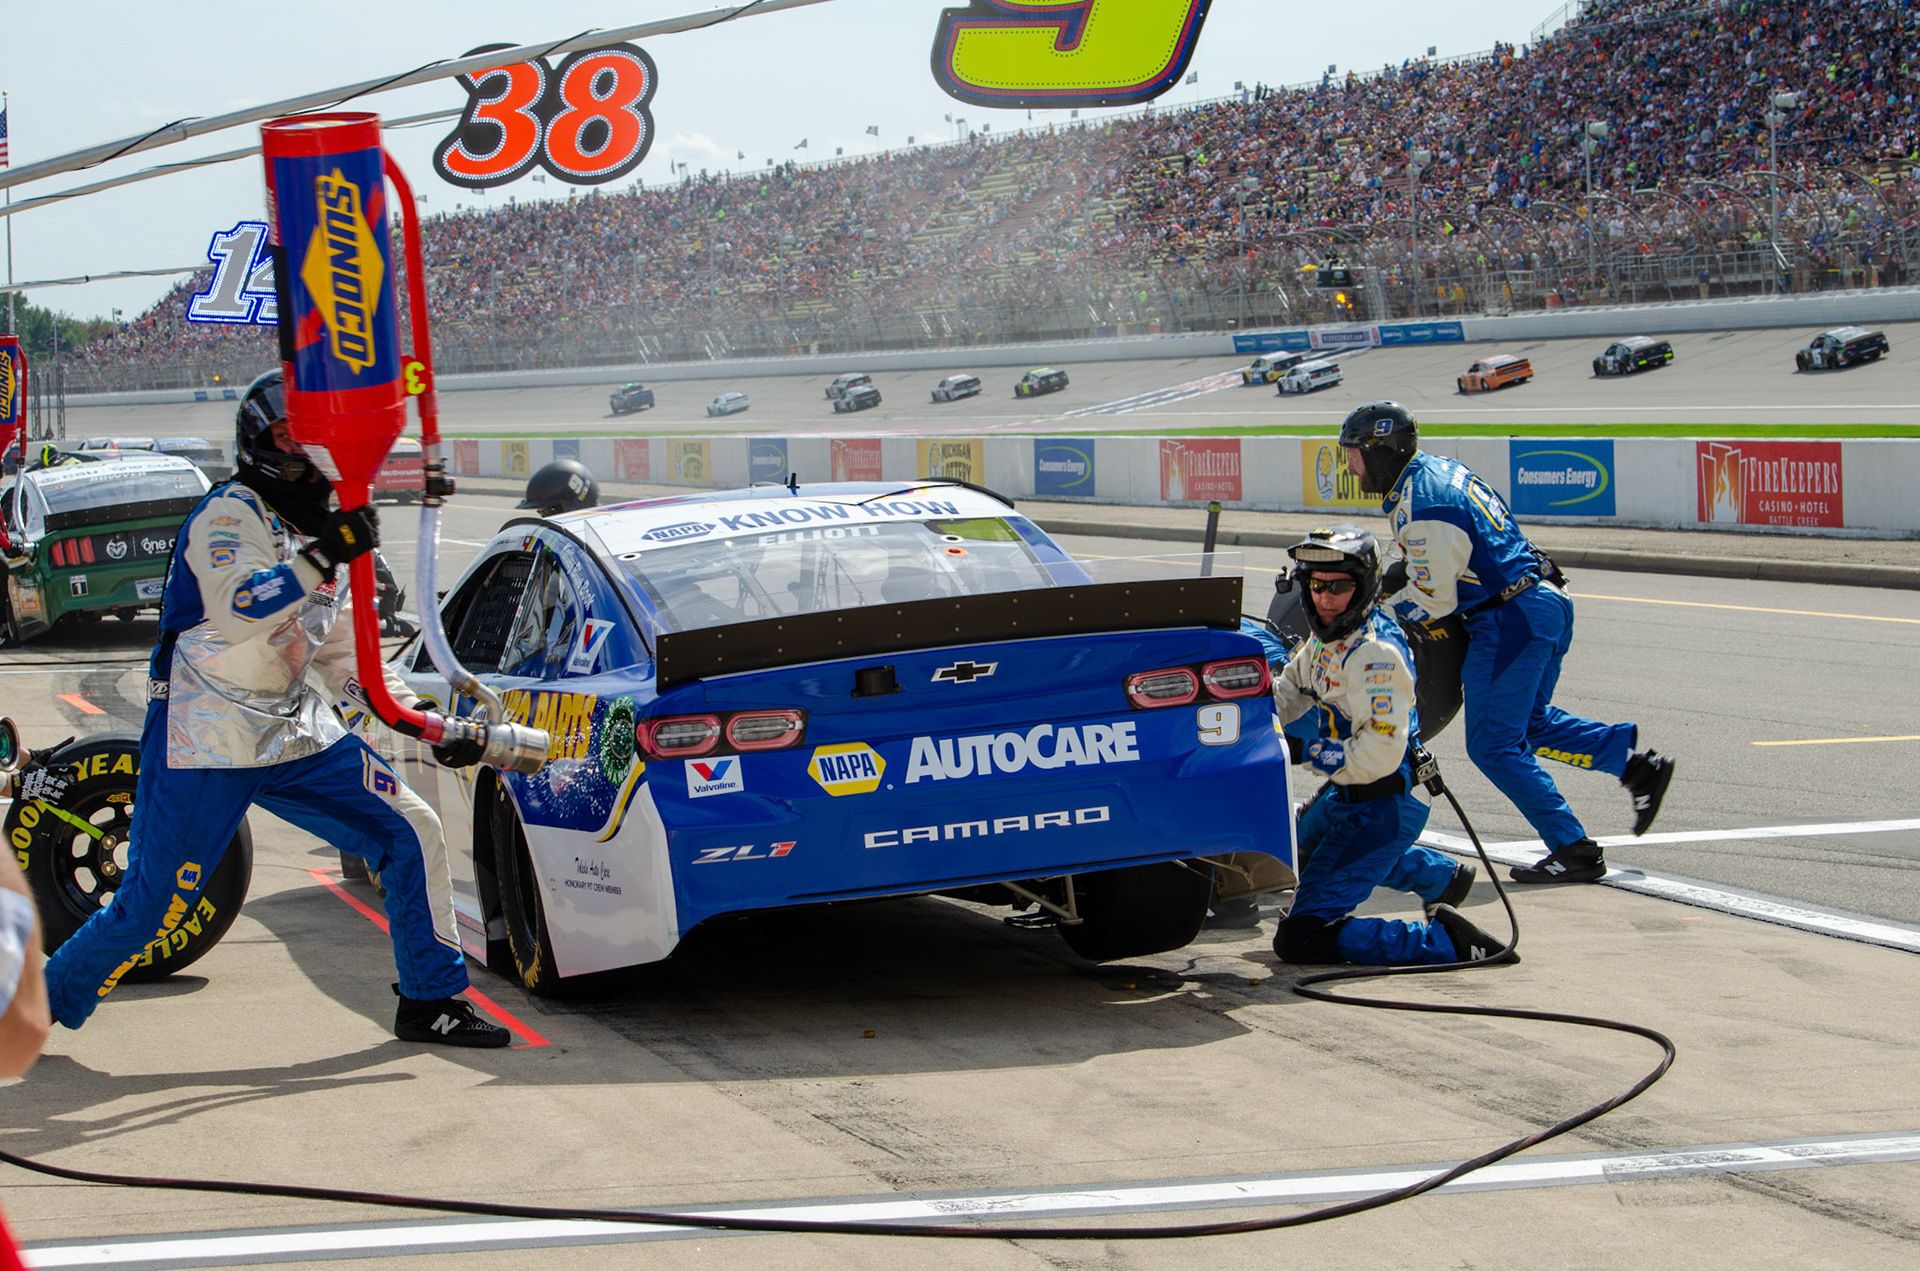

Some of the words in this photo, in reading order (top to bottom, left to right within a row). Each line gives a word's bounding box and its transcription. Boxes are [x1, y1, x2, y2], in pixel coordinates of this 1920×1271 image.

[438, 46, 654, 184] 38
[319, 180, 370, 364] SUNOCO
[1374, 419, 1393, 436] 9
[941, 442, 971, 461] MICHIGAN
[1517, 467, 1566, 485] Consumers
[1566, 467, 1597, 488] Energy
[718, 504, 850, 531] KNOW
[859, 501, 960, 517] HOW
[1759, 500, 1793, 513] CASINO
[1800, 501, 1829, 514] HOTEL
[651, 524, 706, 540] NAPA
[759, 525, 880, 546] ELLIOTT
[533, 692, 598, 762] PARTS
[1197, 703, 1240, 745] 9
[818, 753, 877, 782] NAPA
[1536, 746, 1594, 769] PARTS
[694, 781, 737, 793] Valvoline
[864, 805, 1110, 849] CAMARO
[691, 841, 797, 865] ZL1
[138, 896, 217, 968] EAGLE
